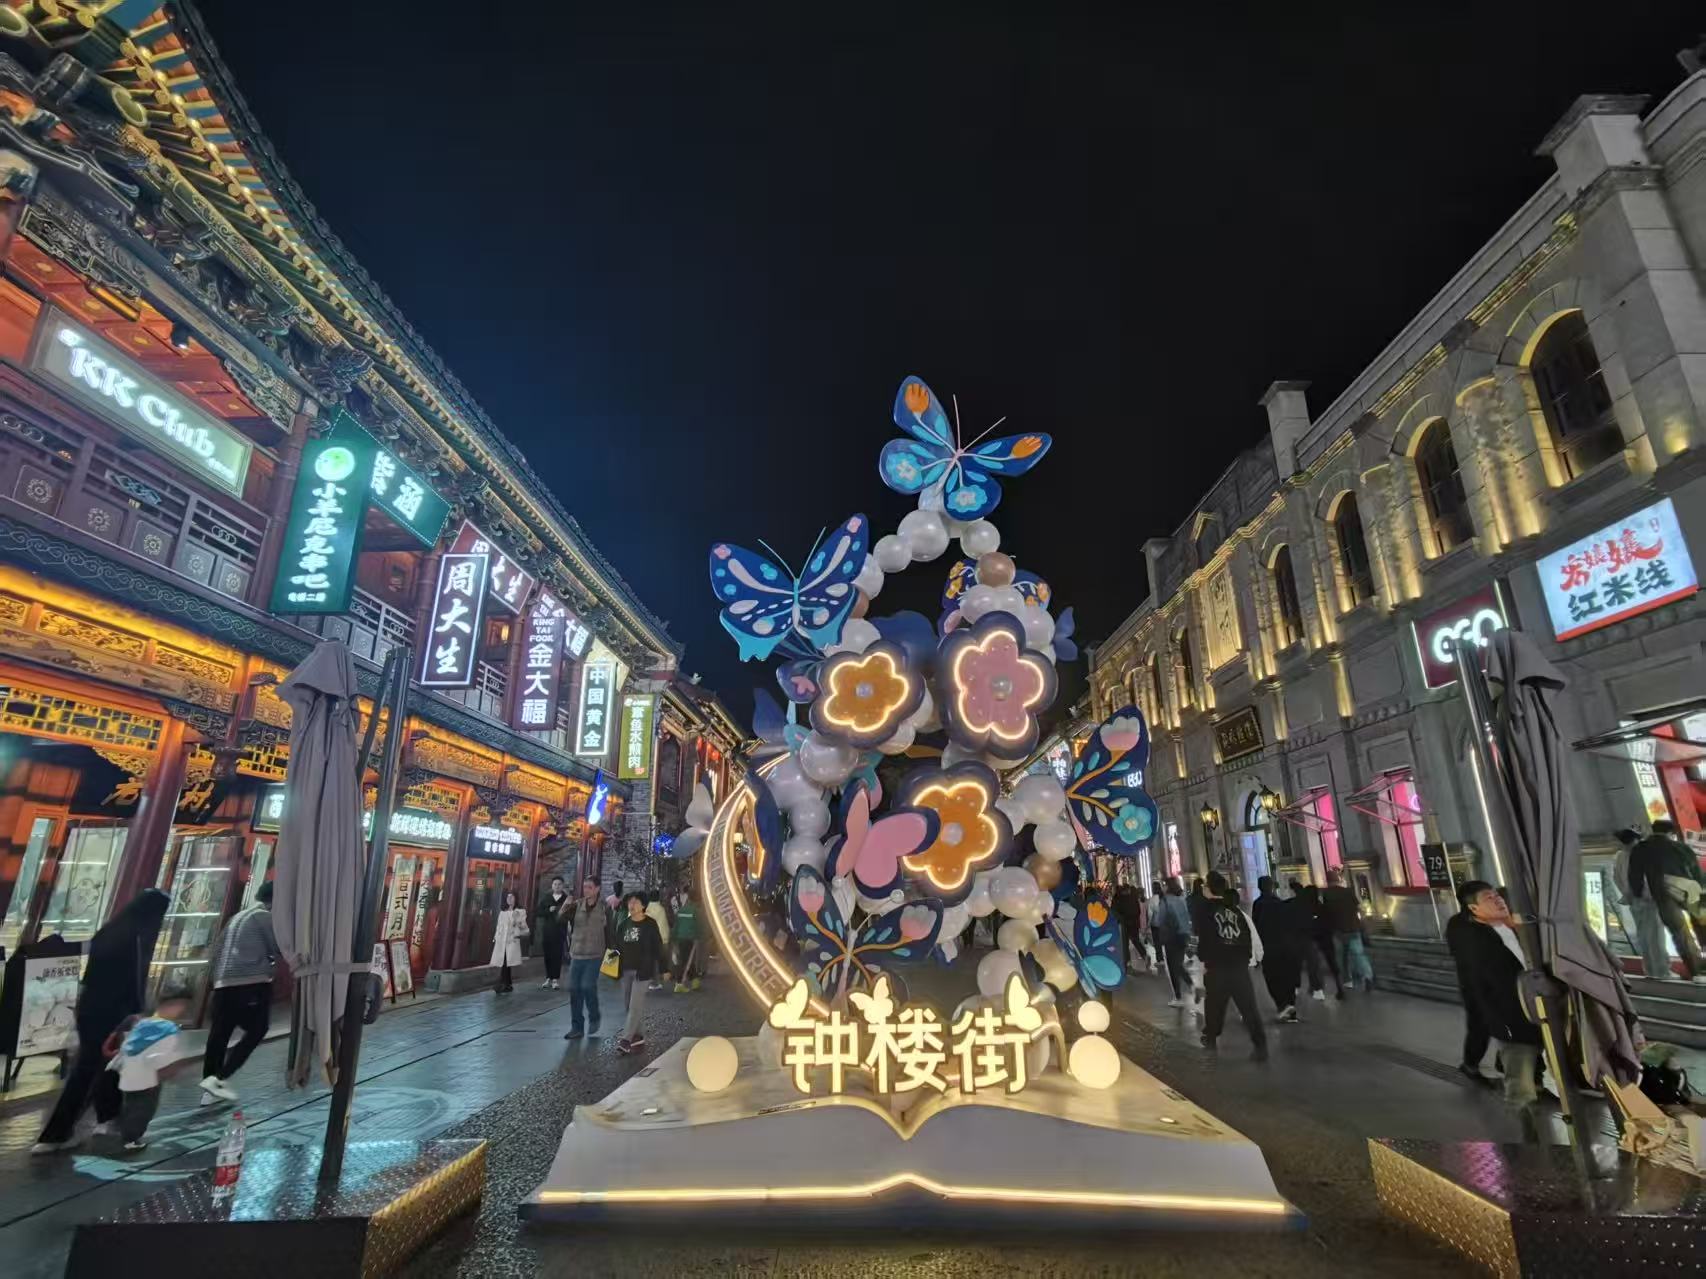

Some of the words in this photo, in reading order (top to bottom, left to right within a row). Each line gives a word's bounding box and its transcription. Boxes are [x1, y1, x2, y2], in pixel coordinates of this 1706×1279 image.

[70, 347, 139, 408] KK
[137, 394, 215, 457] Club
[434, 561, 477, 675] 周大生
[536, 626, 551, 634] TAI
[1567, 559, 1675, 622] 红米线
[521, 643, 553, 724] 金大福
[583, 668, 606, 748] 中国黄金
[784, 1006, 1032, 1094] 钟楼街
